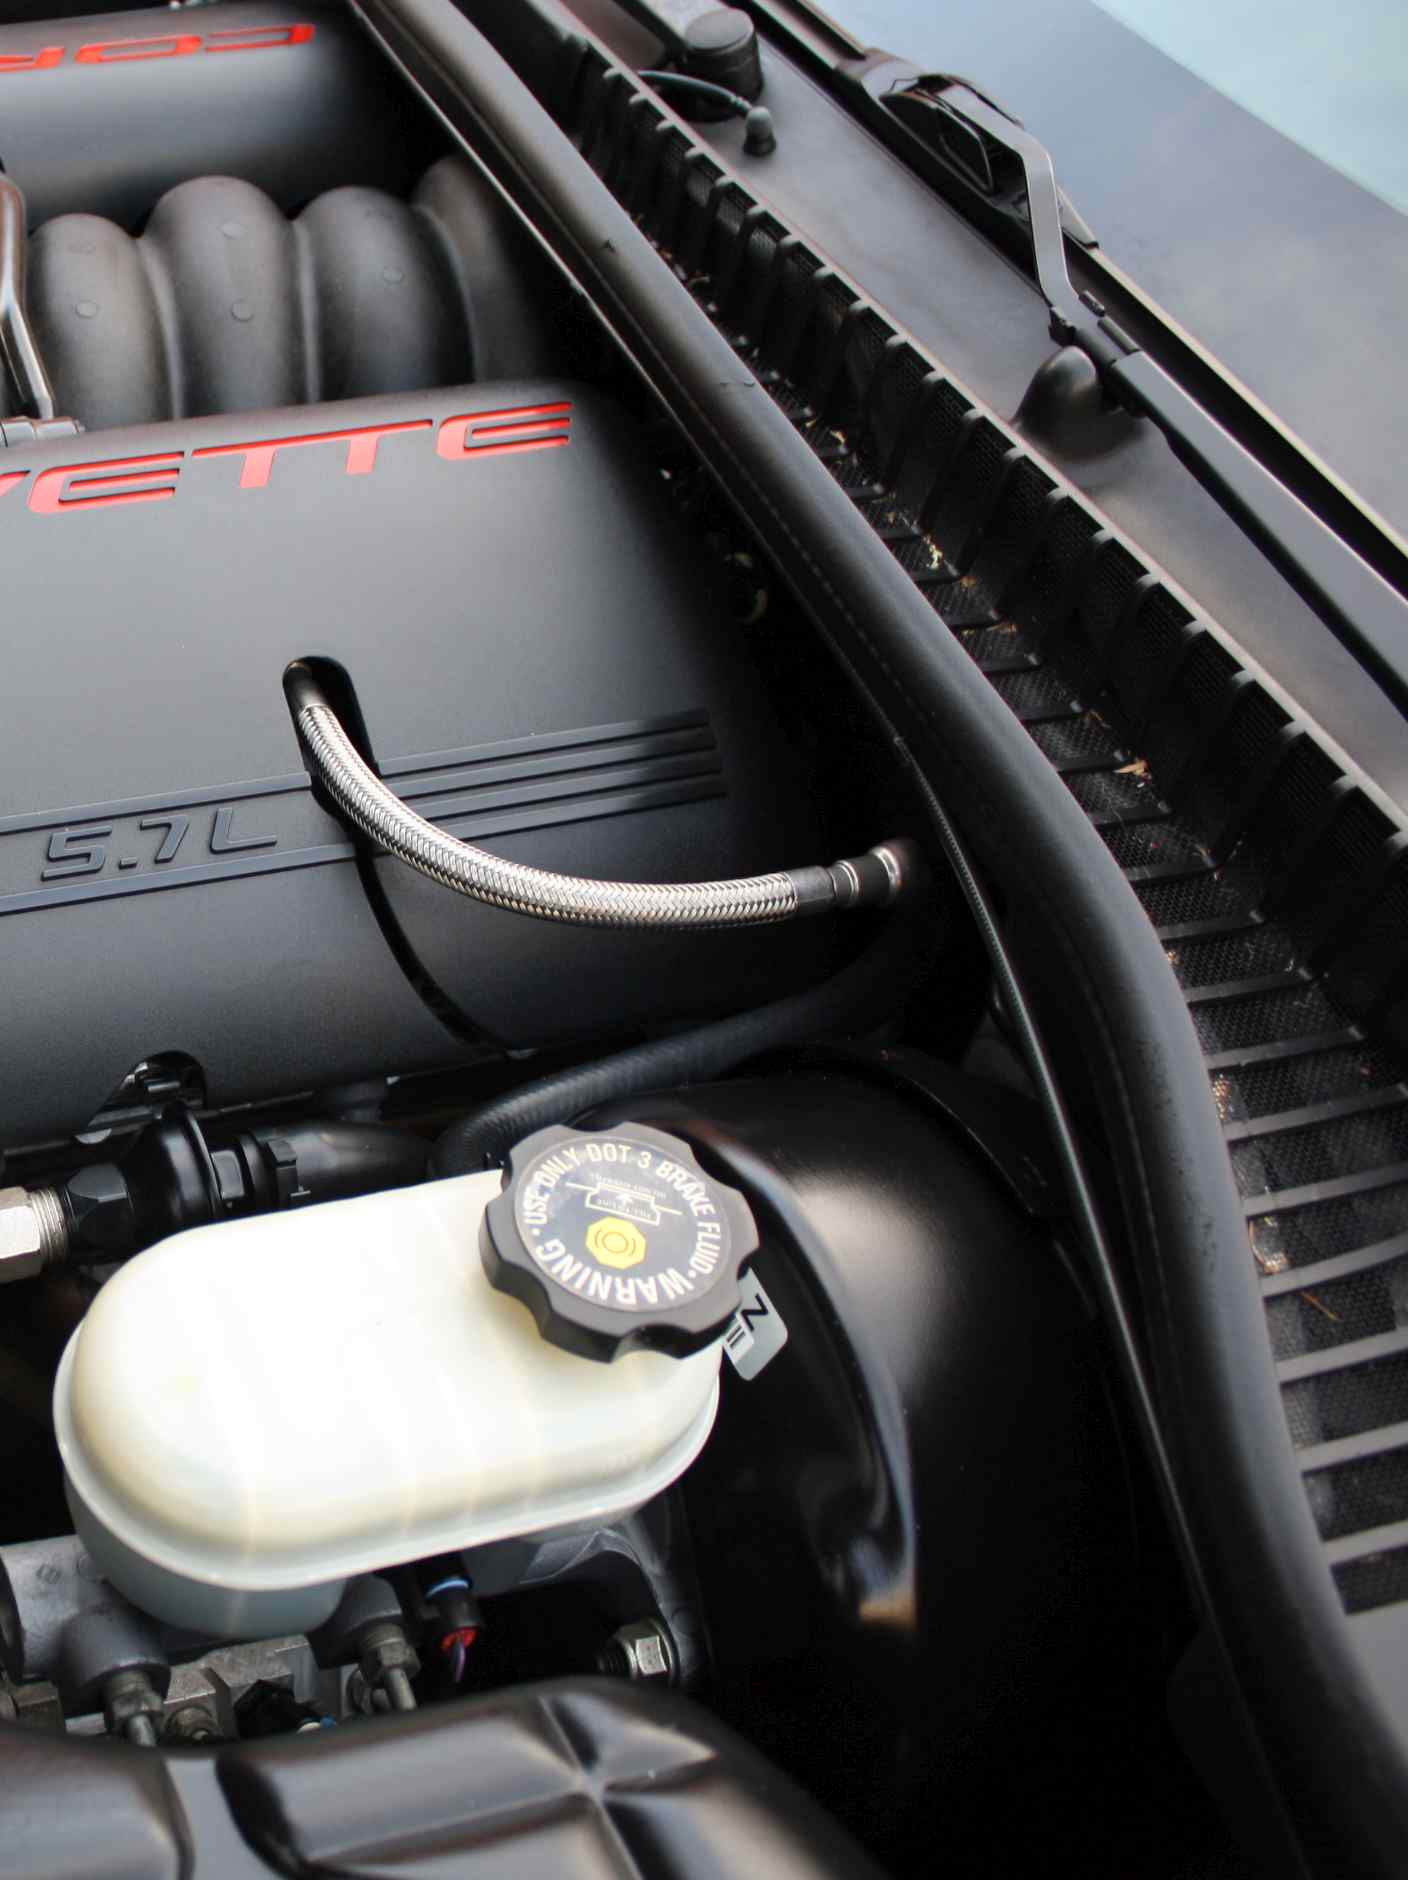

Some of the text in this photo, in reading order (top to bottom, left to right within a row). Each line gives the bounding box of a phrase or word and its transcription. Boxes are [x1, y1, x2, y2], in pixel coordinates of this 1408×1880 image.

[40, 806, 278, 883] 5.7L
[534, 1146, 581, 1188] ONLY
[655, 1159, 715, 1217] BRAKE
[522, 1185, 550, 1226] USE
[535, 1237, 695, 1306] WARNING
[696, 1222, 721, 1276] FLUID
